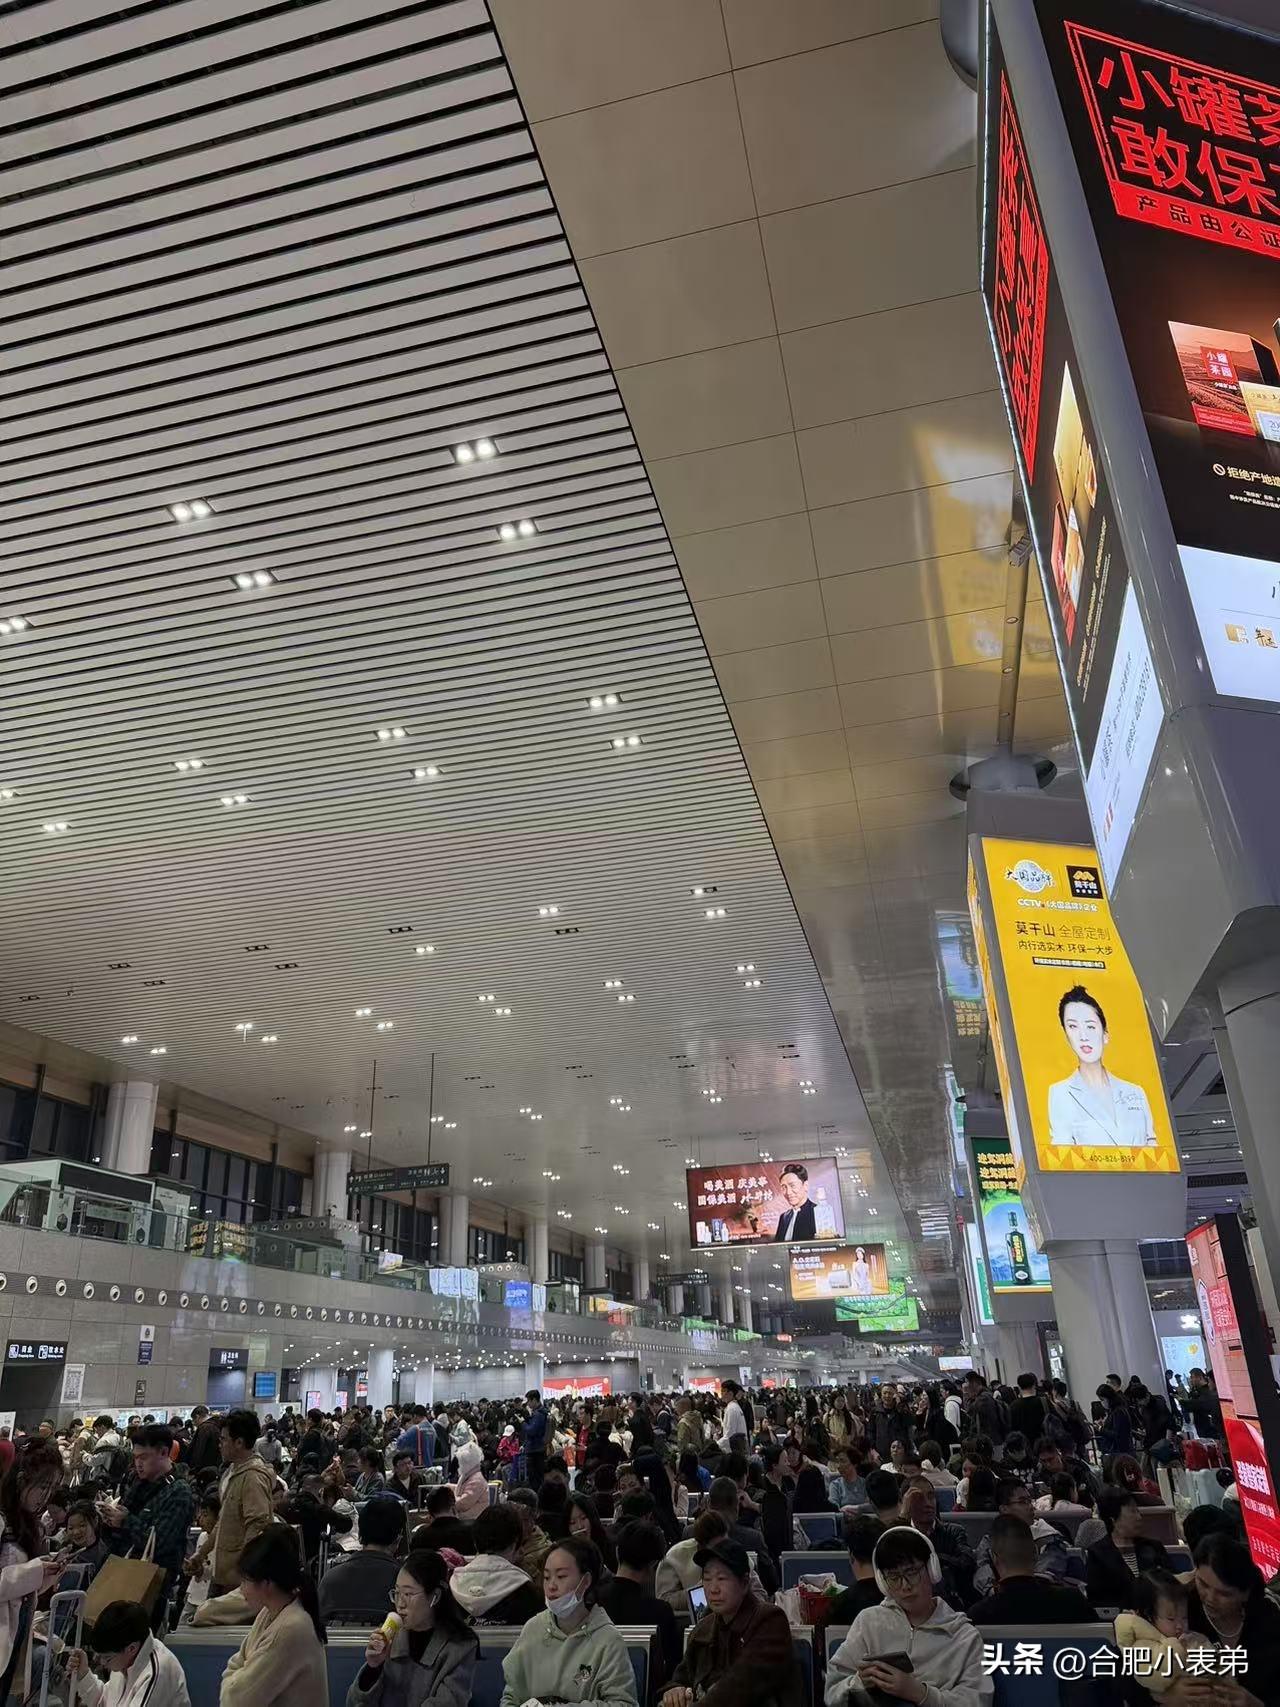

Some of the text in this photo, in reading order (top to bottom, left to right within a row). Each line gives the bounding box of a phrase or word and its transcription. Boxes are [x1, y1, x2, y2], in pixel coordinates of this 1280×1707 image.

[1110, 115, 1280, 217] 敢保
[1016, 921, 1111, 941] 莫干山 全屋定制
